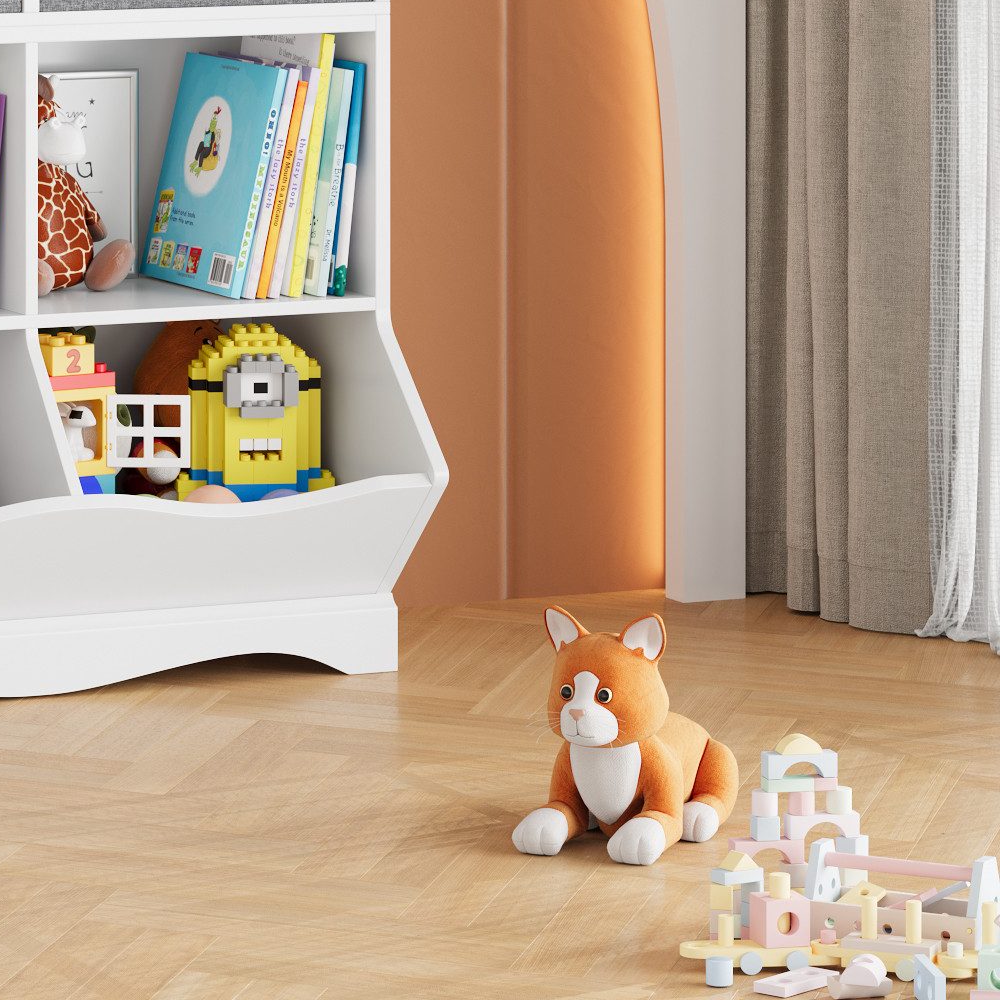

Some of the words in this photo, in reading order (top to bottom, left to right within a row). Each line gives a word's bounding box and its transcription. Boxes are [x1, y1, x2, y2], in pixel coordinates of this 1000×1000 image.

[285, 150, 292, 159] My
[282, 161, 291, 184] Mouth
[274, 199, 284, 226] Volcano
[66, 348, 82, 374] 2
